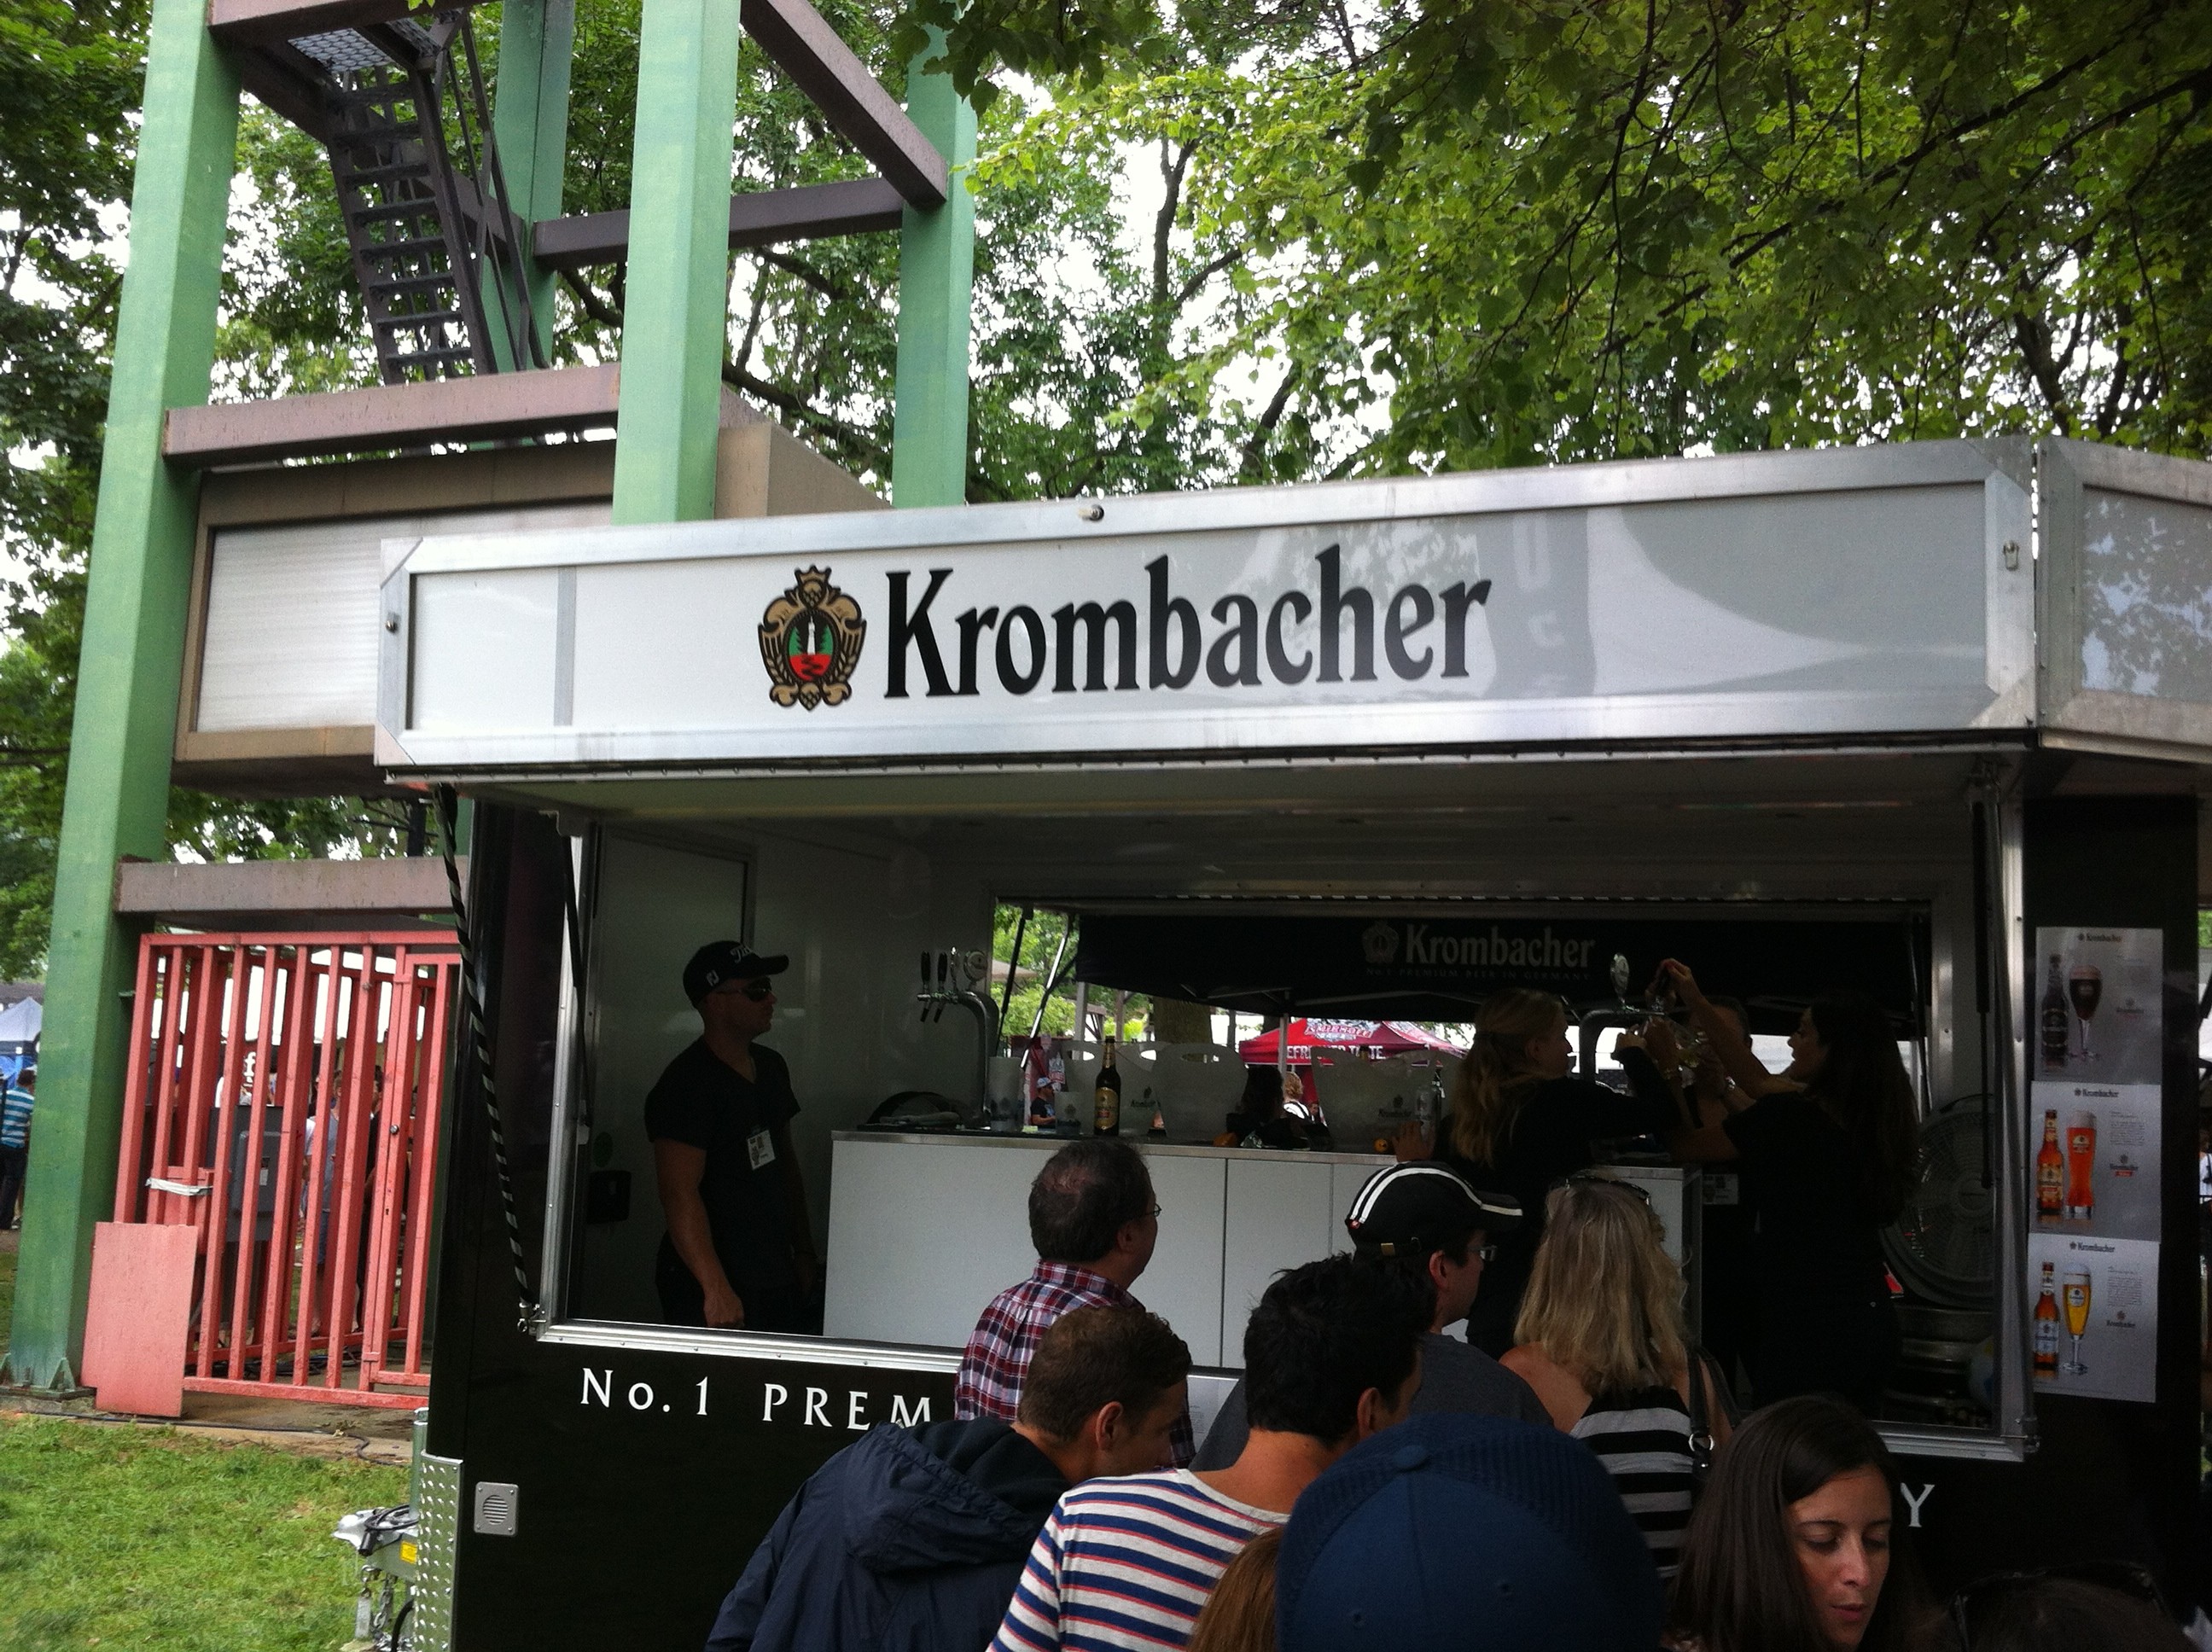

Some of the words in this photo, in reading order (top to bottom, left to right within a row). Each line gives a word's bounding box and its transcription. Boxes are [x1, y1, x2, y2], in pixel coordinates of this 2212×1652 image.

[883, 544, 1493, 699] Krombacher
[1406, 924, 1596, 968] Krombacher
[762, 1382, 931, 1431] PREM
